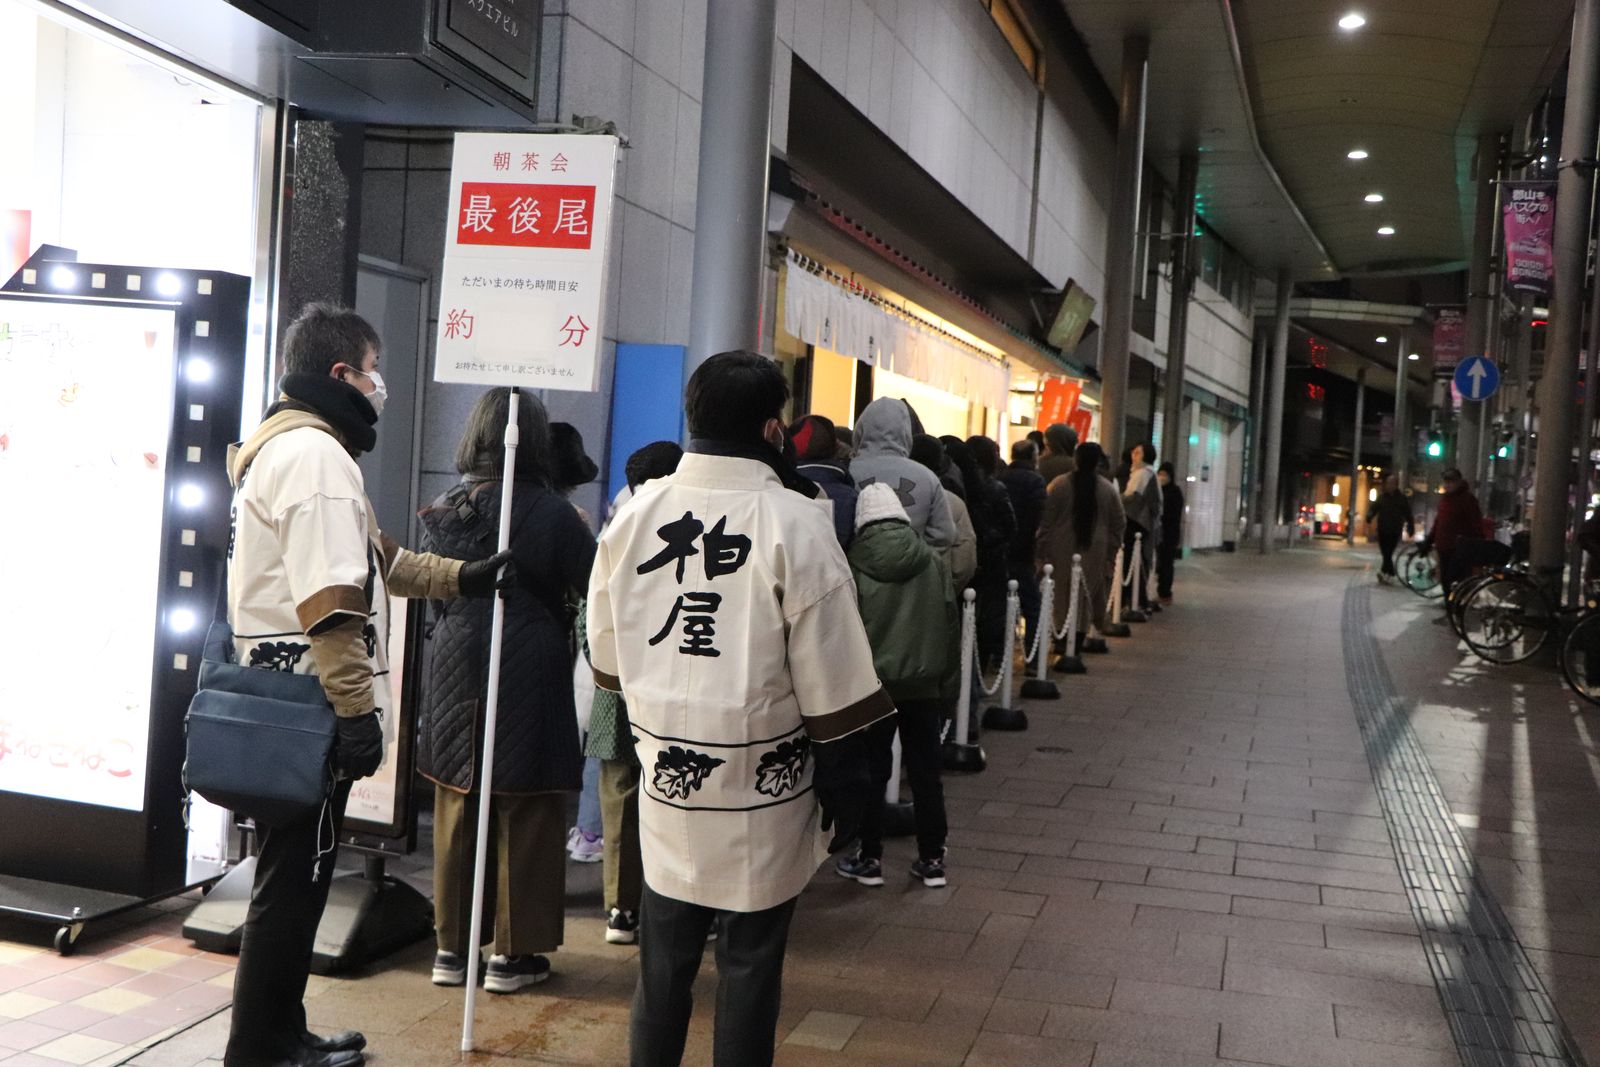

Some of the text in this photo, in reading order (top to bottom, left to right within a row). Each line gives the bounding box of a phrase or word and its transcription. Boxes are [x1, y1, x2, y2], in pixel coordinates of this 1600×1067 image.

[493, 152, 569, 173] 朝茶会
[462, 194, 589, 235] 最後尾
[1508, 201, 1549, 213] バスケの
[462, 276, 578, 292] ただいまの待ち時間目安
[444, 308, 590, 347] 約 分
[455, 361, 574, 377] お待たせして申し訳ございません
[636, 510, 752, 658] 柏屋
